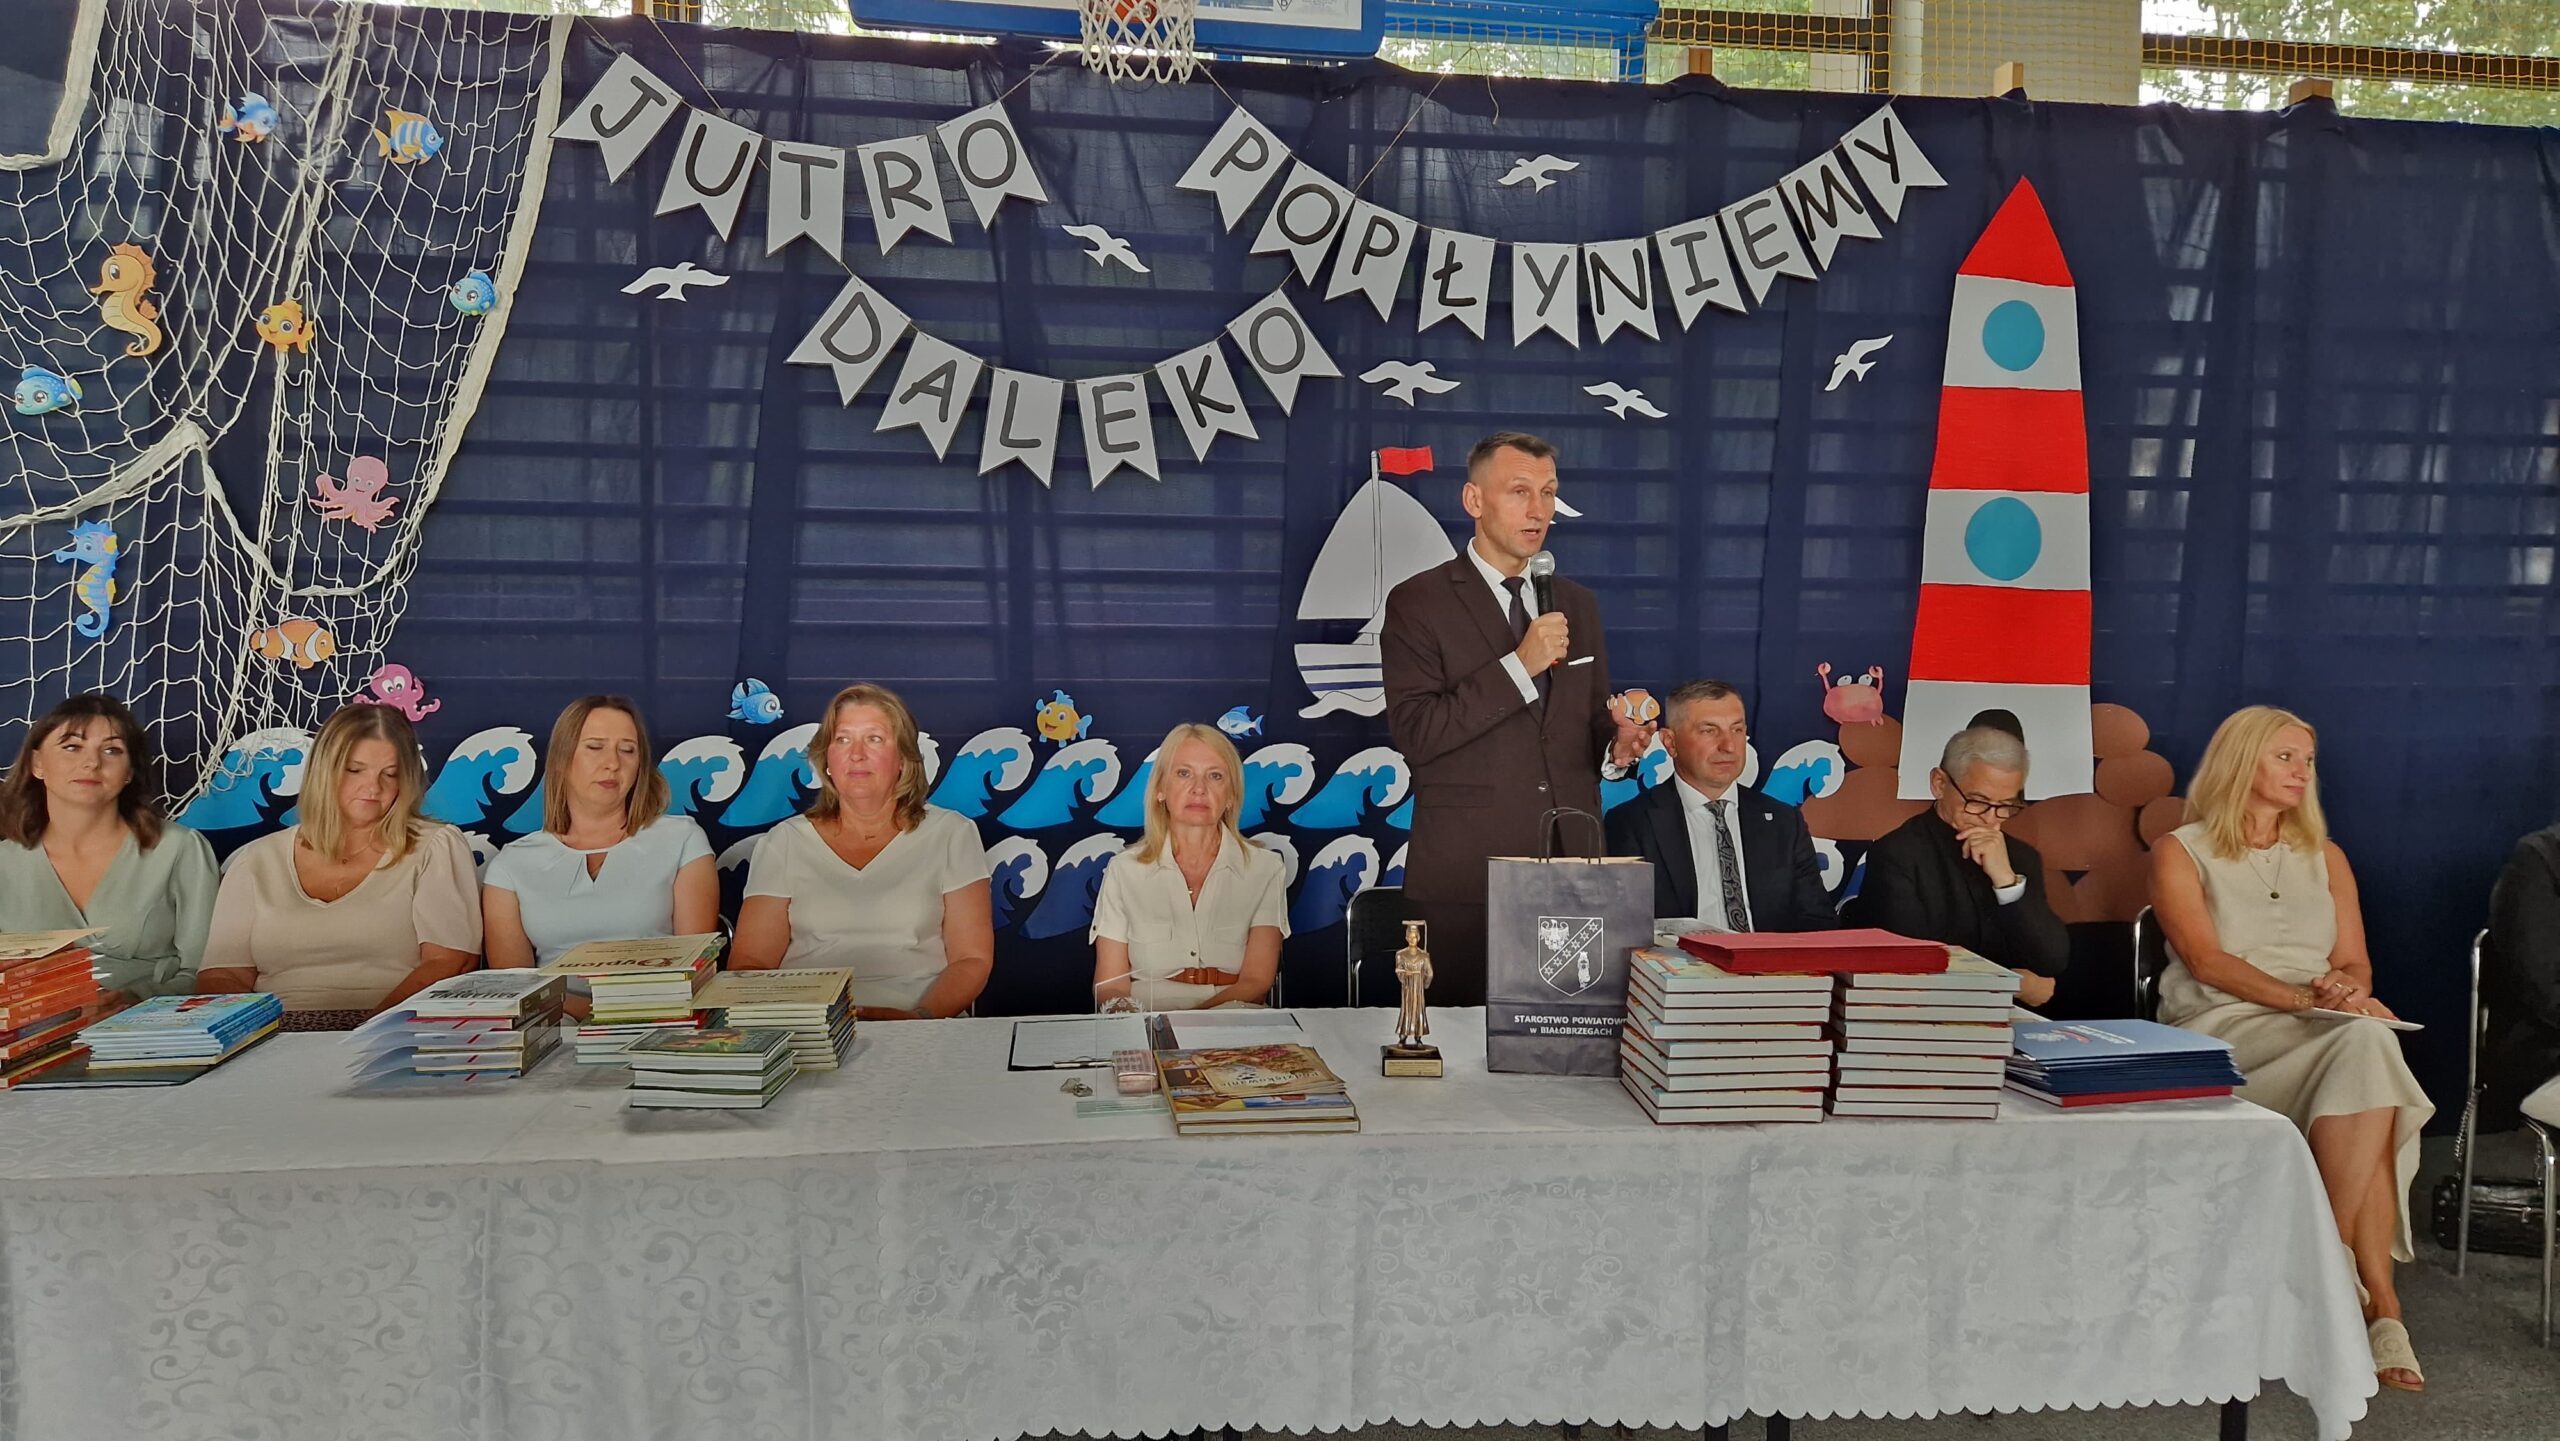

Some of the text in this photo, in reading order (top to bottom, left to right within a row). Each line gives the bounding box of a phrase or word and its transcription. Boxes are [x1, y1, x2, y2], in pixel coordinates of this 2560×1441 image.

[590, 75, 1017, 221] JUTRO
[1209, 116, 1901, 316] POPŁYNIEMY
[820, 291, 1306, 454] DALEKO
[1514, 1014, 1569, 1025] STAROSTWO
[1540, 1026, 1613, 1036] BIAŁOBRZEGACH
